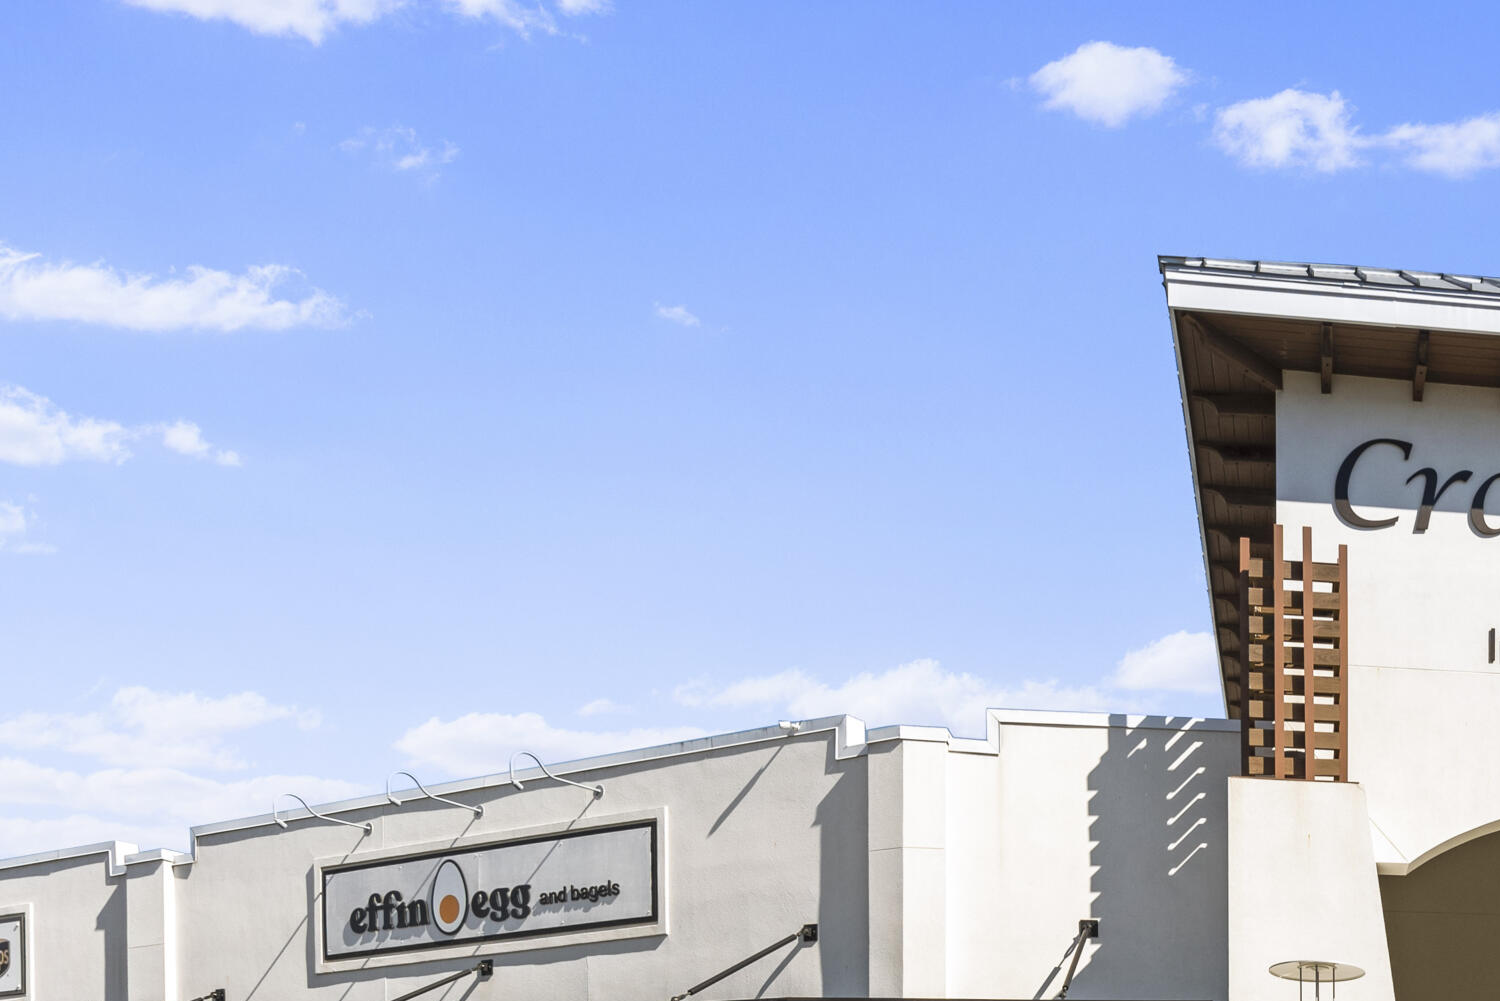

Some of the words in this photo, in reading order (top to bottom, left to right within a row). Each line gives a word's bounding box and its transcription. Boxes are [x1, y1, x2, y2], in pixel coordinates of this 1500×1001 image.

[350, 890, 430, 934] effin
[471, 884, 531, 922] egg
[539, 887, 567, 906] and
[570, 880, 621, 902] bagels
